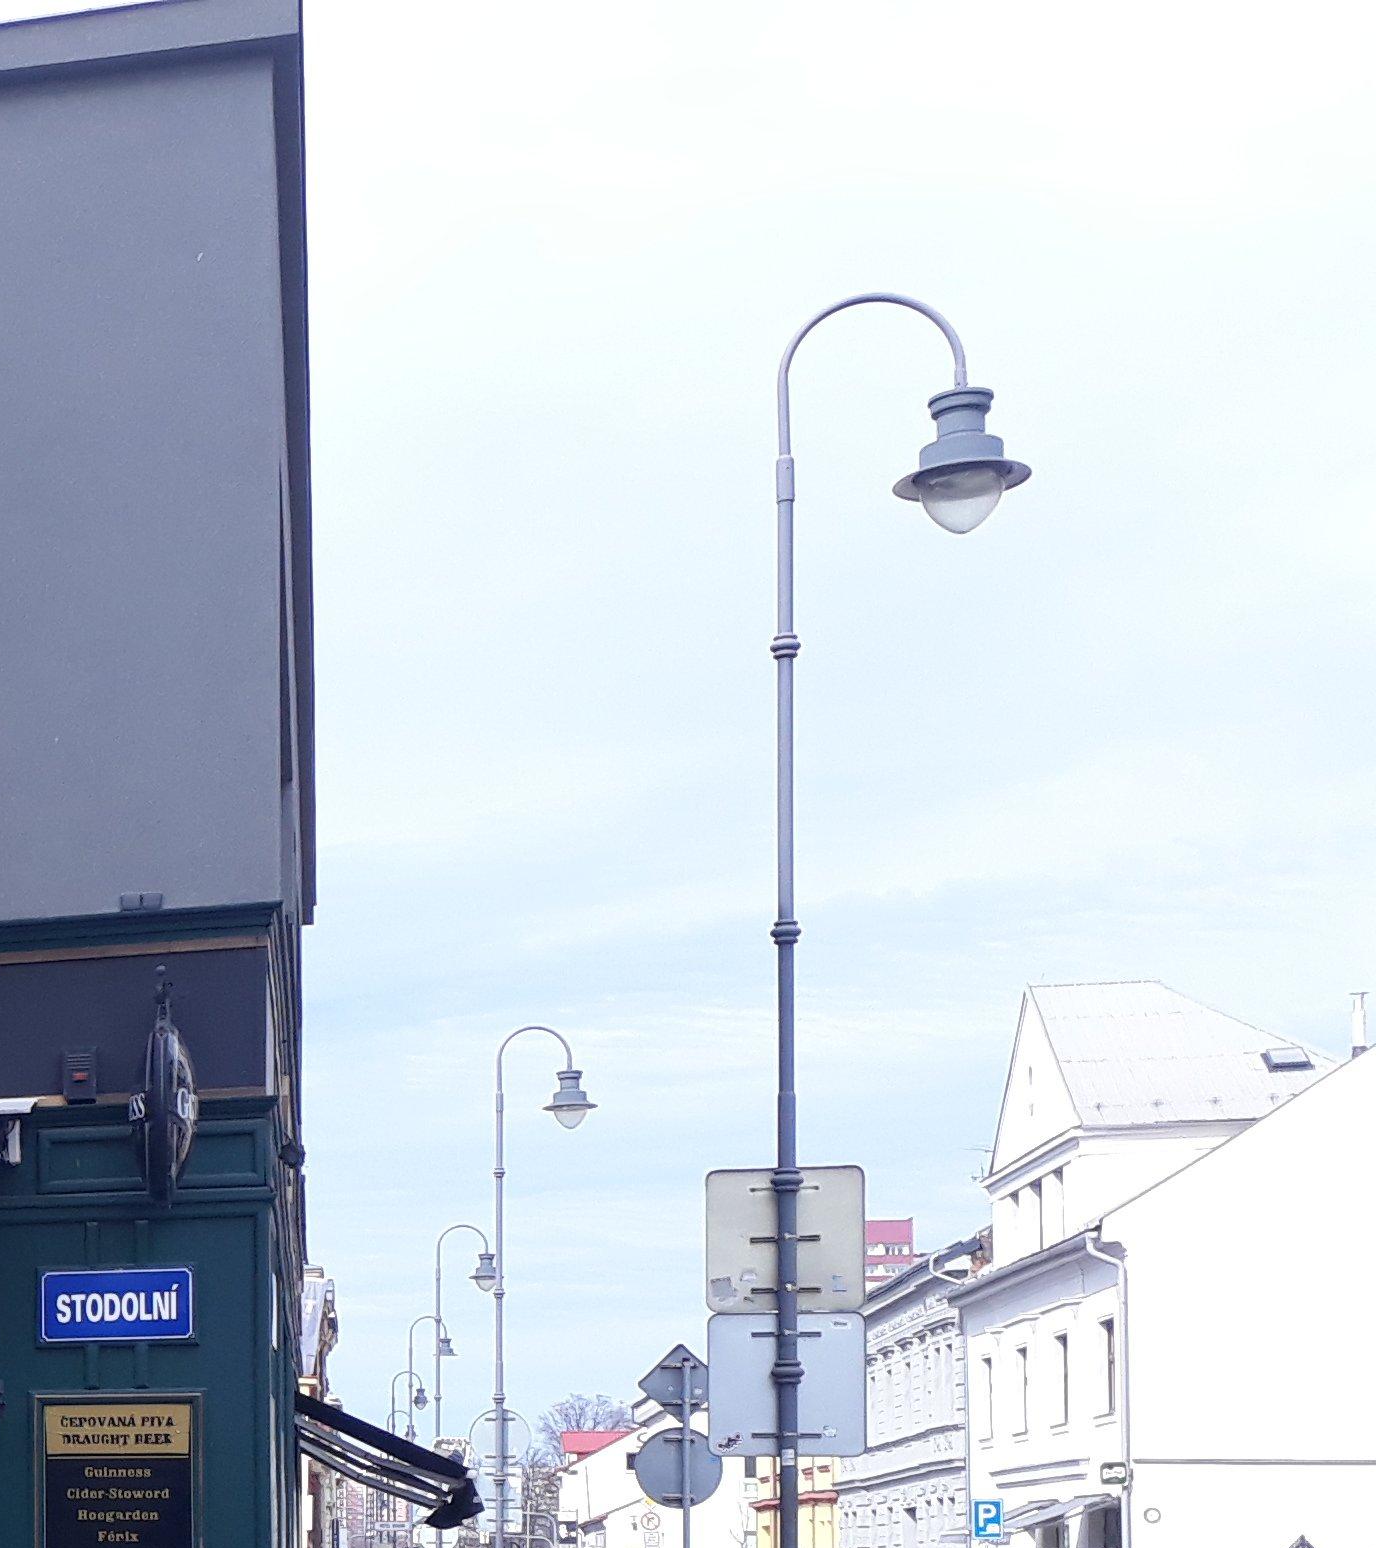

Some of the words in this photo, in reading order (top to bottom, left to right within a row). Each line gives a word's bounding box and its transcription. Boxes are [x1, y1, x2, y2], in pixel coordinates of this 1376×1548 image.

[56, 1283, 179, 1324] STODOLNÍ
[141, 1415, 176, 1427] PIVA
[62, 1434, 129, 1445] DRAUGHT
[84, 1466, 152, 1478] Guinness
